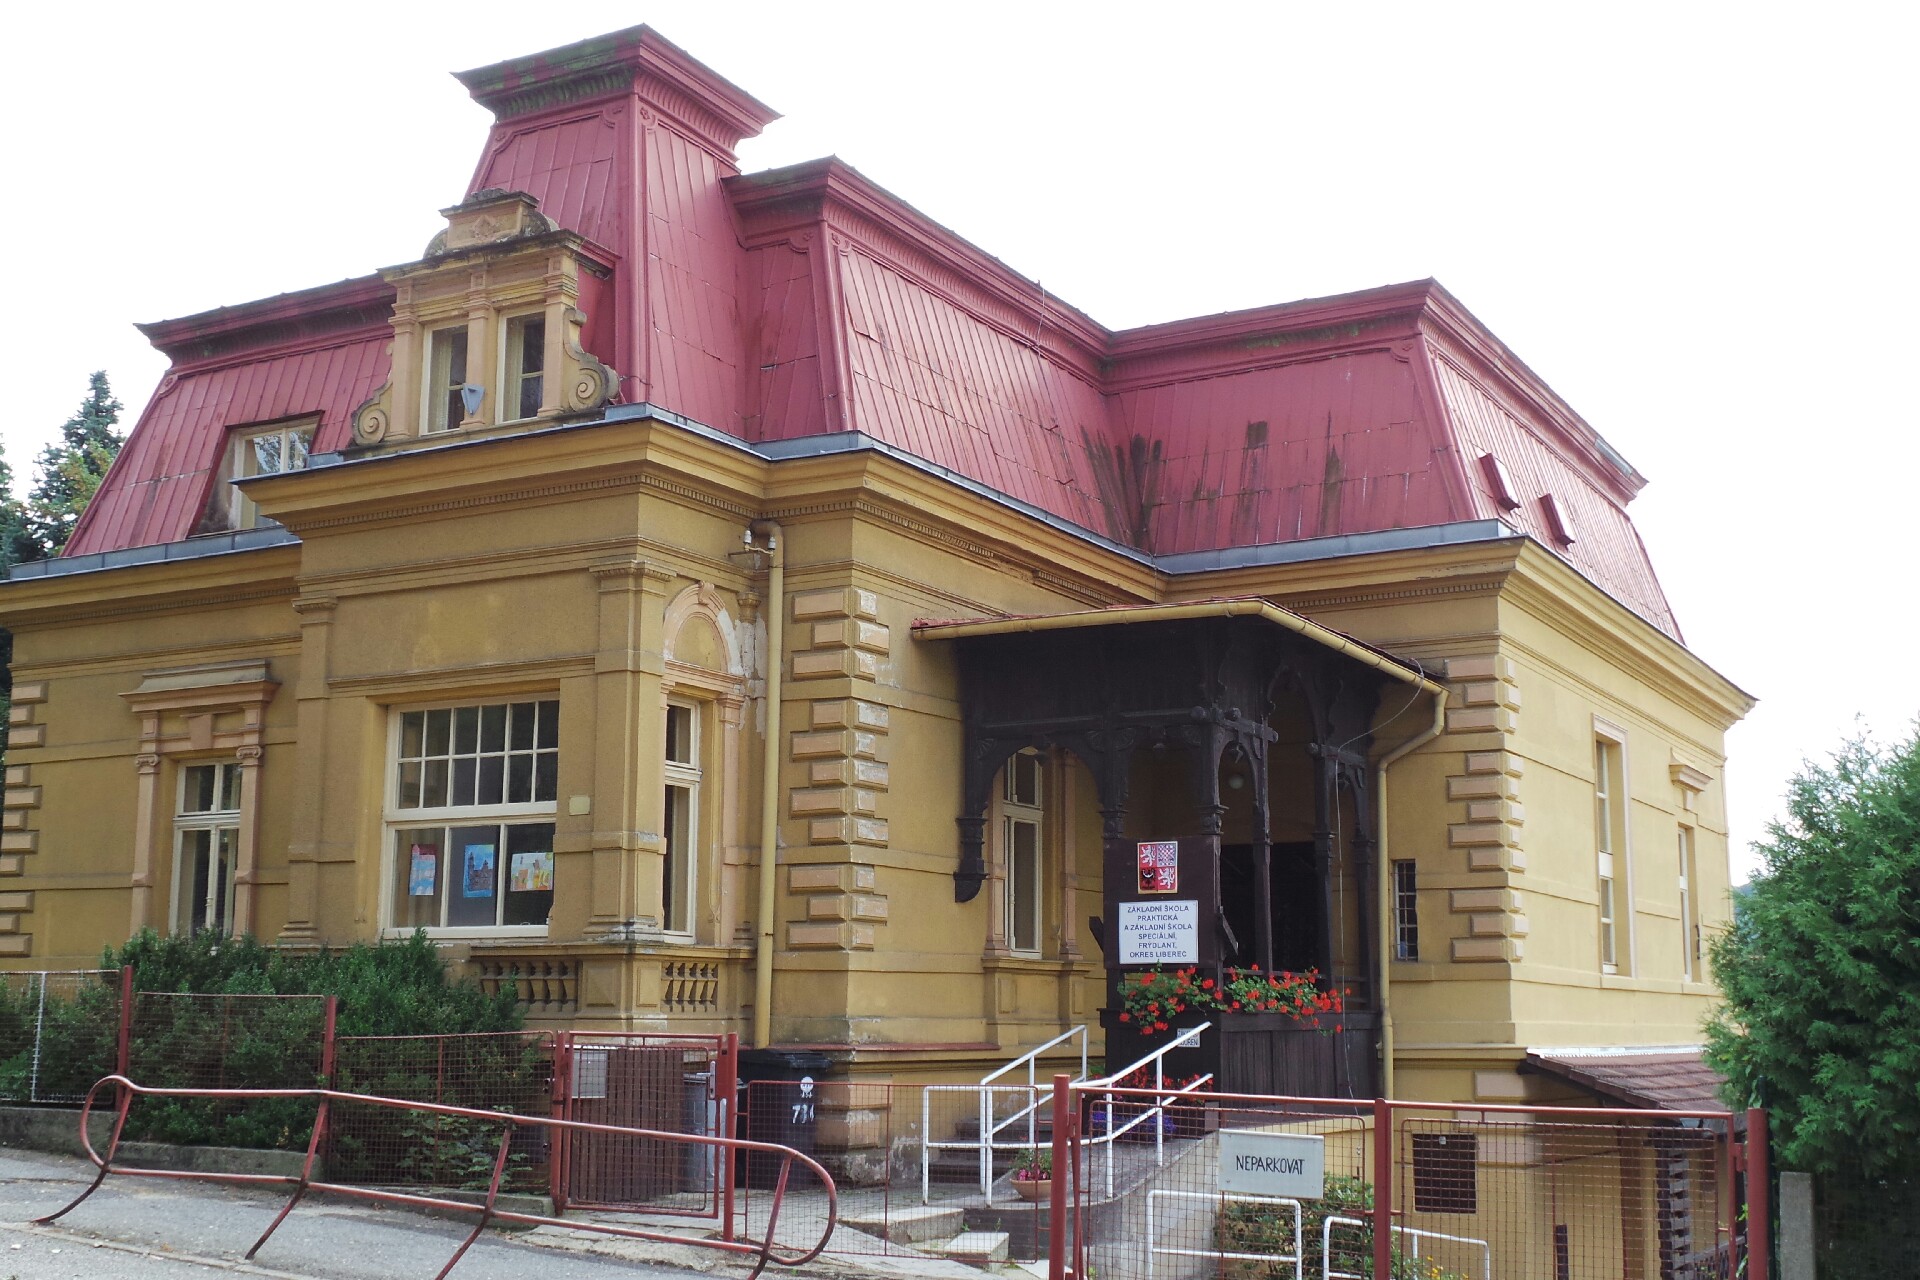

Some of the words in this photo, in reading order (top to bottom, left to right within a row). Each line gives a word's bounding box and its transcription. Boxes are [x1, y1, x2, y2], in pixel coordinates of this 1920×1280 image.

[1127, 905, 1162, 914] ZÁKLADNÍ
[1164, 904, 1190, 912] ŠKOLA
[1137, 914, 1179, 922] PRAKTICKÁ
[1130, 923, 1166, 931] ZÁKLADNÍ
[1236, 1154, 1306, 1175] NEPARKOVAT
